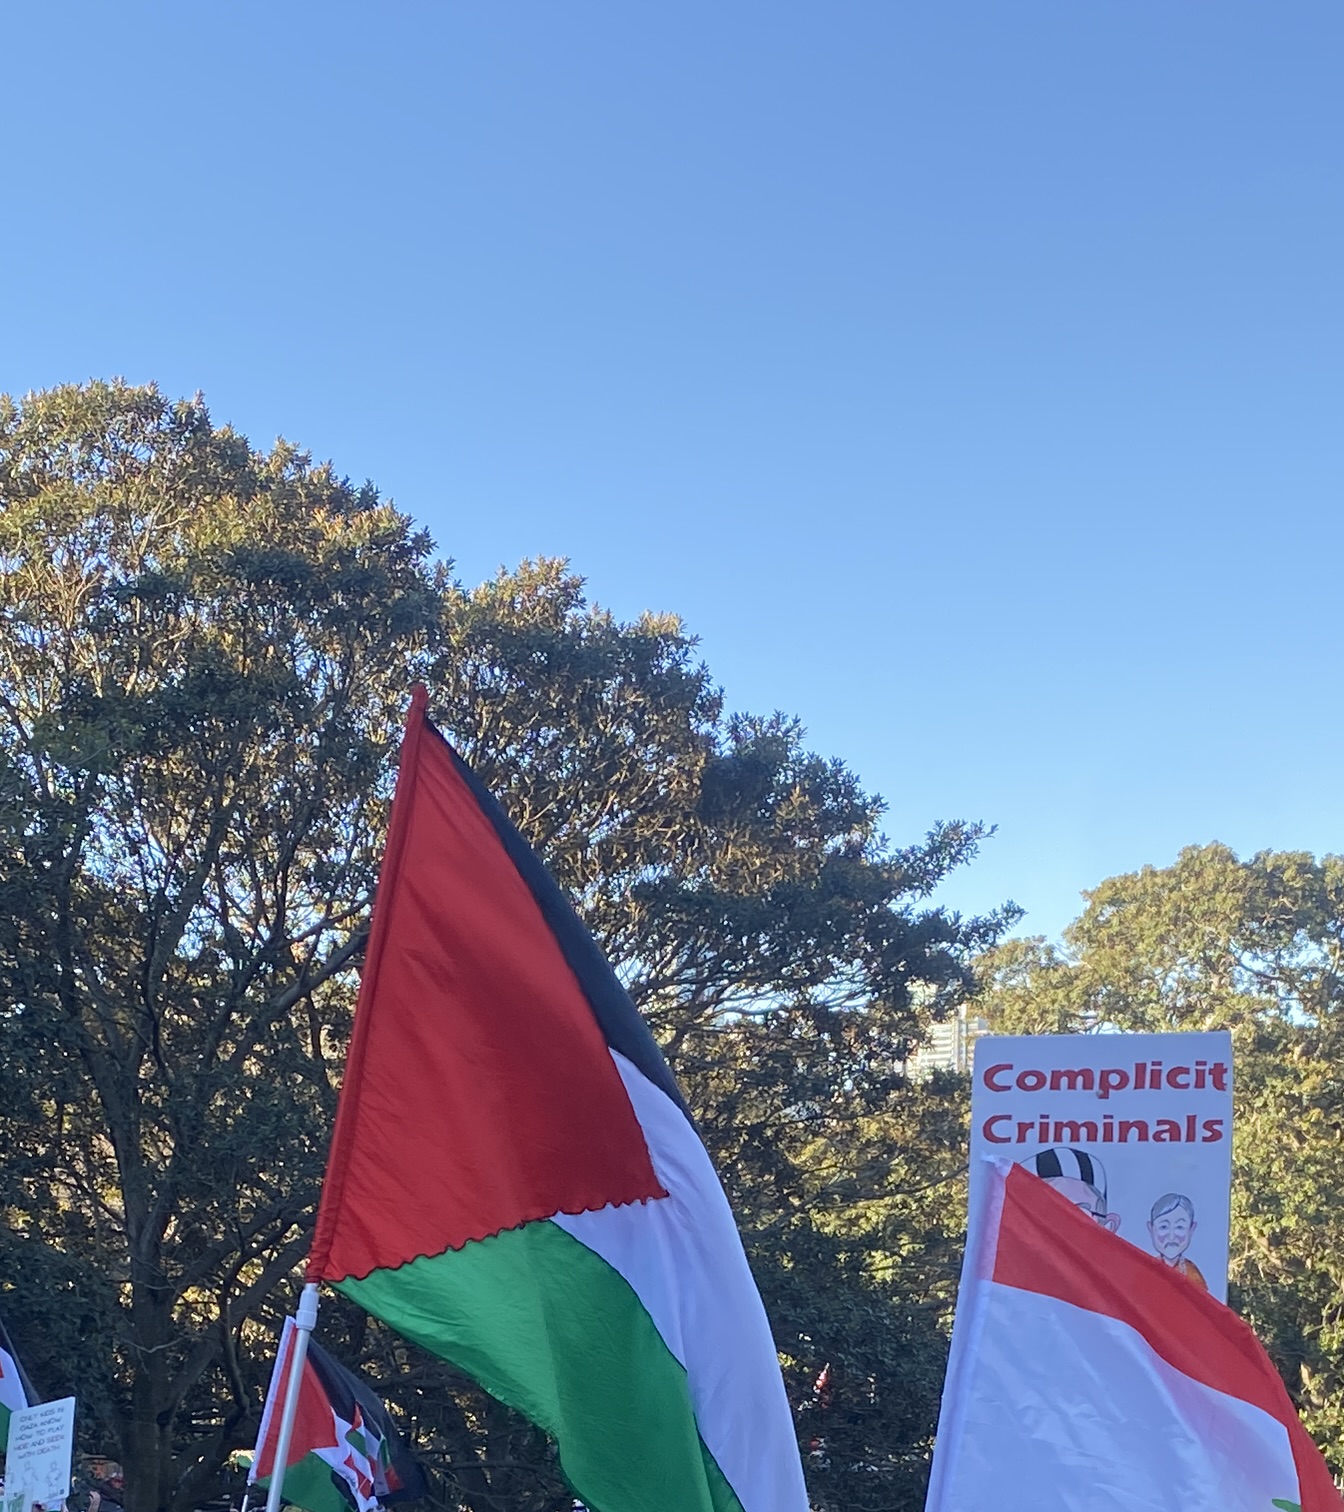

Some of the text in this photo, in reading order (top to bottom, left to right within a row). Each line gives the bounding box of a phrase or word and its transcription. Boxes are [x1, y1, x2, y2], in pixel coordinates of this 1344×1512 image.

[983, 1061, 1228, 1099] Complicit
[982, 1114, 1224, 1143] Criminals
[36, 1428, 46, 1436] TO
[48, 1424, 64, 1433] PLAY
[40, 1418, 61, 1426] KNOW
